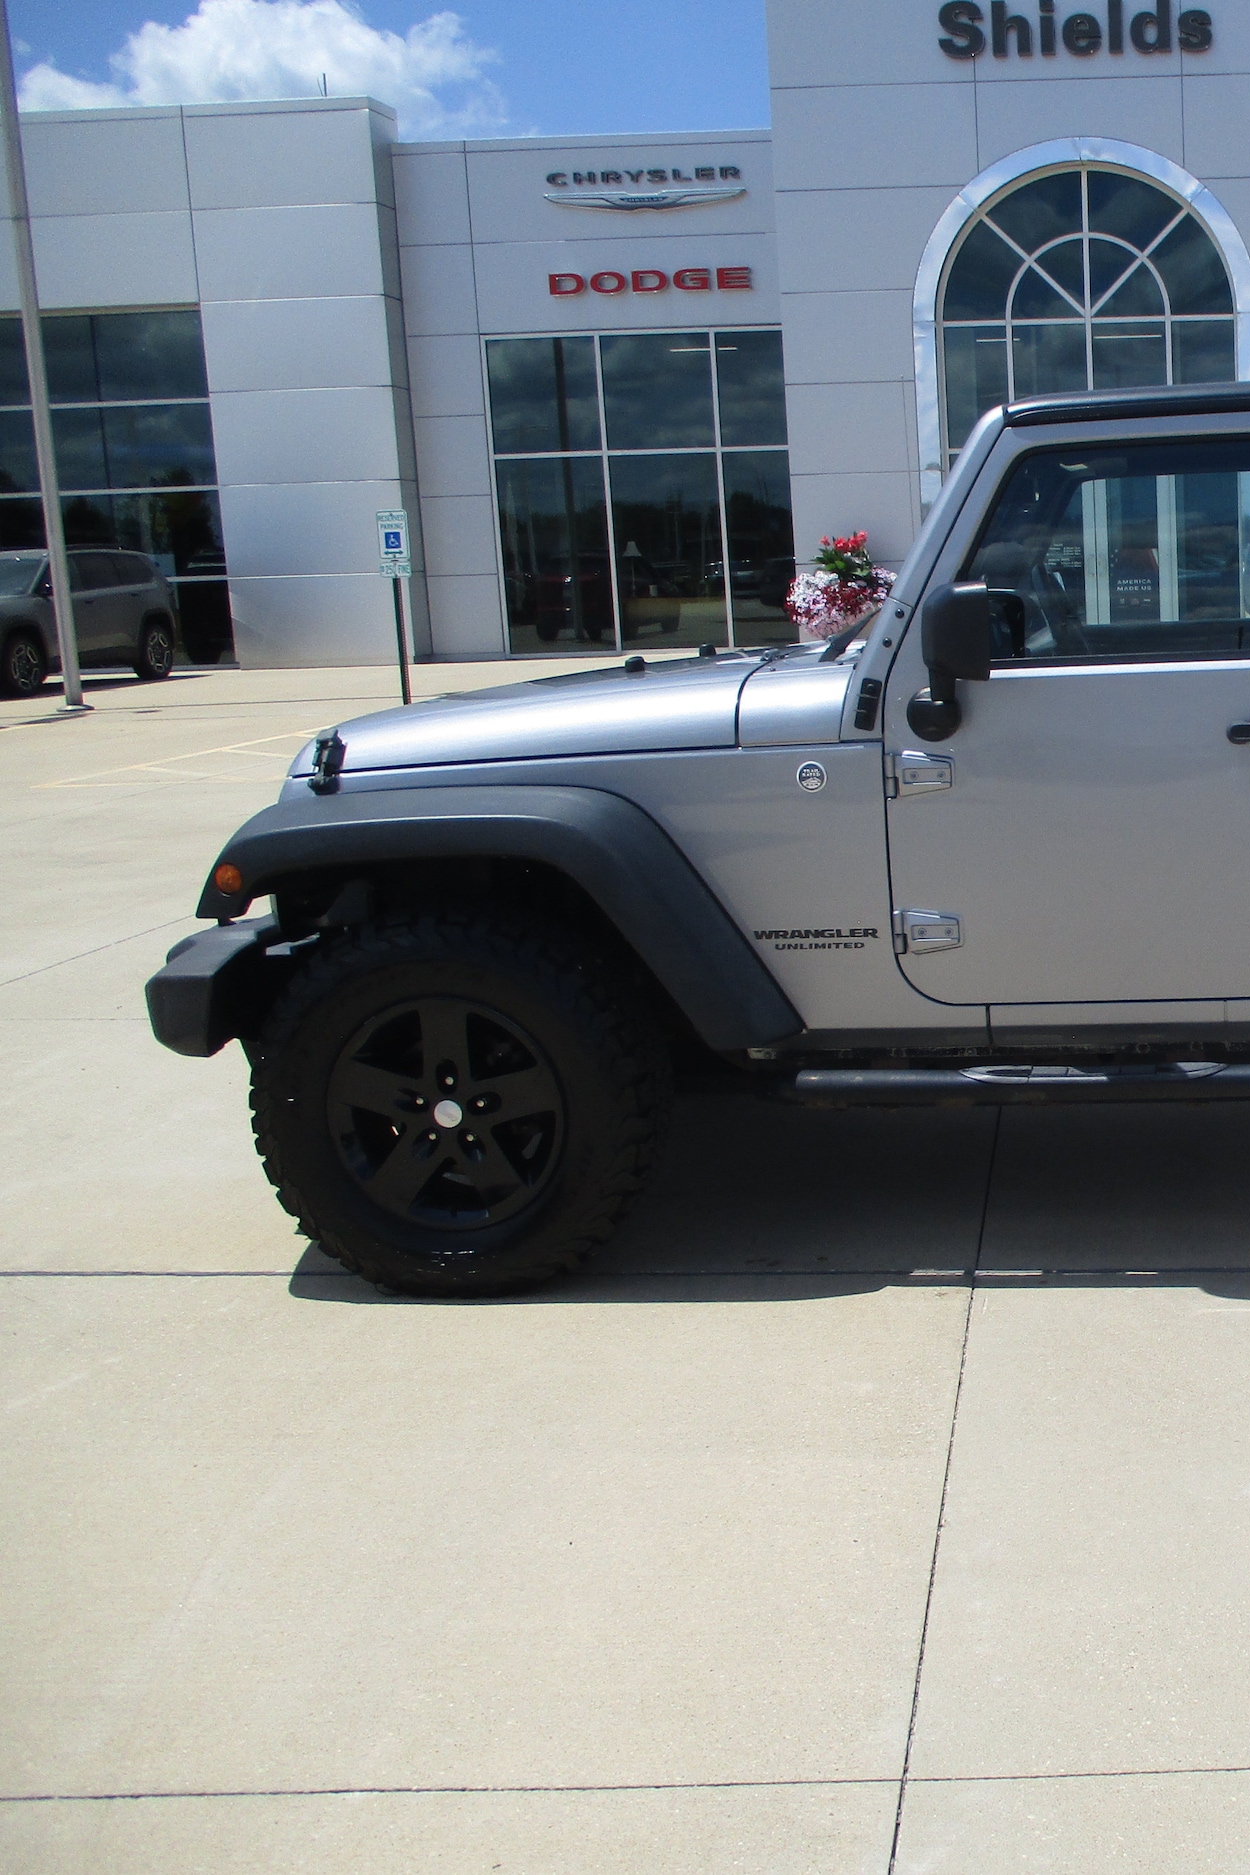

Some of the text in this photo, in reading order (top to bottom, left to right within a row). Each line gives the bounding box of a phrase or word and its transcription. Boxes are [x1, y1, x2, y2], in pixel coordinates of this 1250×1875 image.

[938, 0, 1213, 58] Shields
[546, 166, 740, 186] CHRYSLER
[548, 266, 752, 295] DODGE
[377, 514, 405, 522] RESERVED
[753, 928, 880, 940] WRANGLER
[775, 942, 866, 950] UNLIMITED
